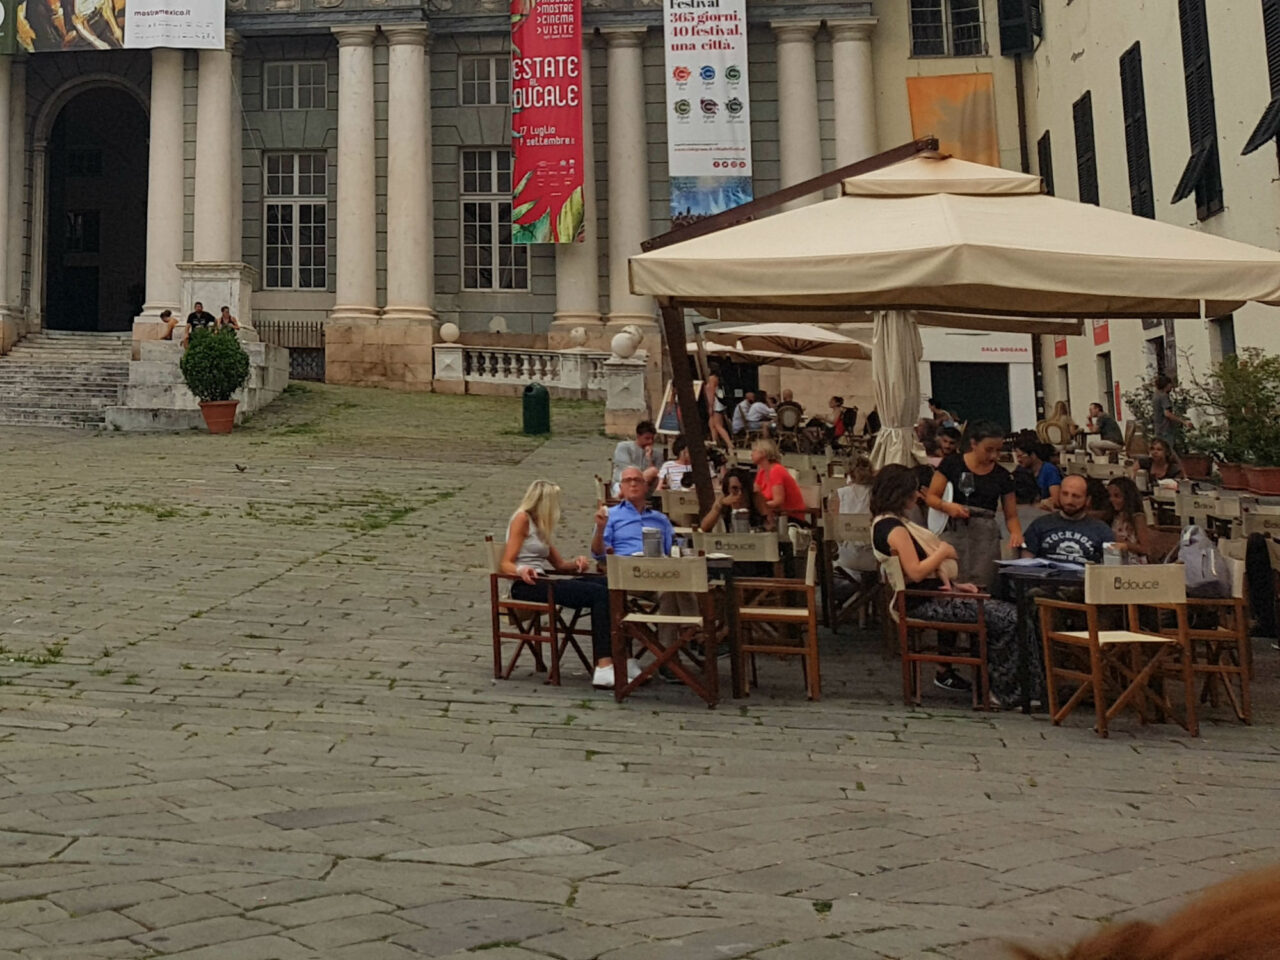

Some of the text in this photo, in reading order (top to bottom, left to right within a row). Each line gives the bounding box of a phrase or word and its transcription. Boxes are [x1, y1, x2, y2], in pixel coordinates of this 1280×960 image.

[134, 8, 191, 17] mostramexico.it
[541, 3, 574, 13] MOSTRE
[541, 14, 574, 24] CINEMA
[670, 11, 695, 23] 365
[542, 24, 574, 34] VISITE
[670, 26, 689, 37] 40
[671, 39, 735, 51] una città.
[513, 56, 579, 80] ESTATE
[513, 85, 579, 108] DUCALE
[526, 136, 570, 146] settembre
